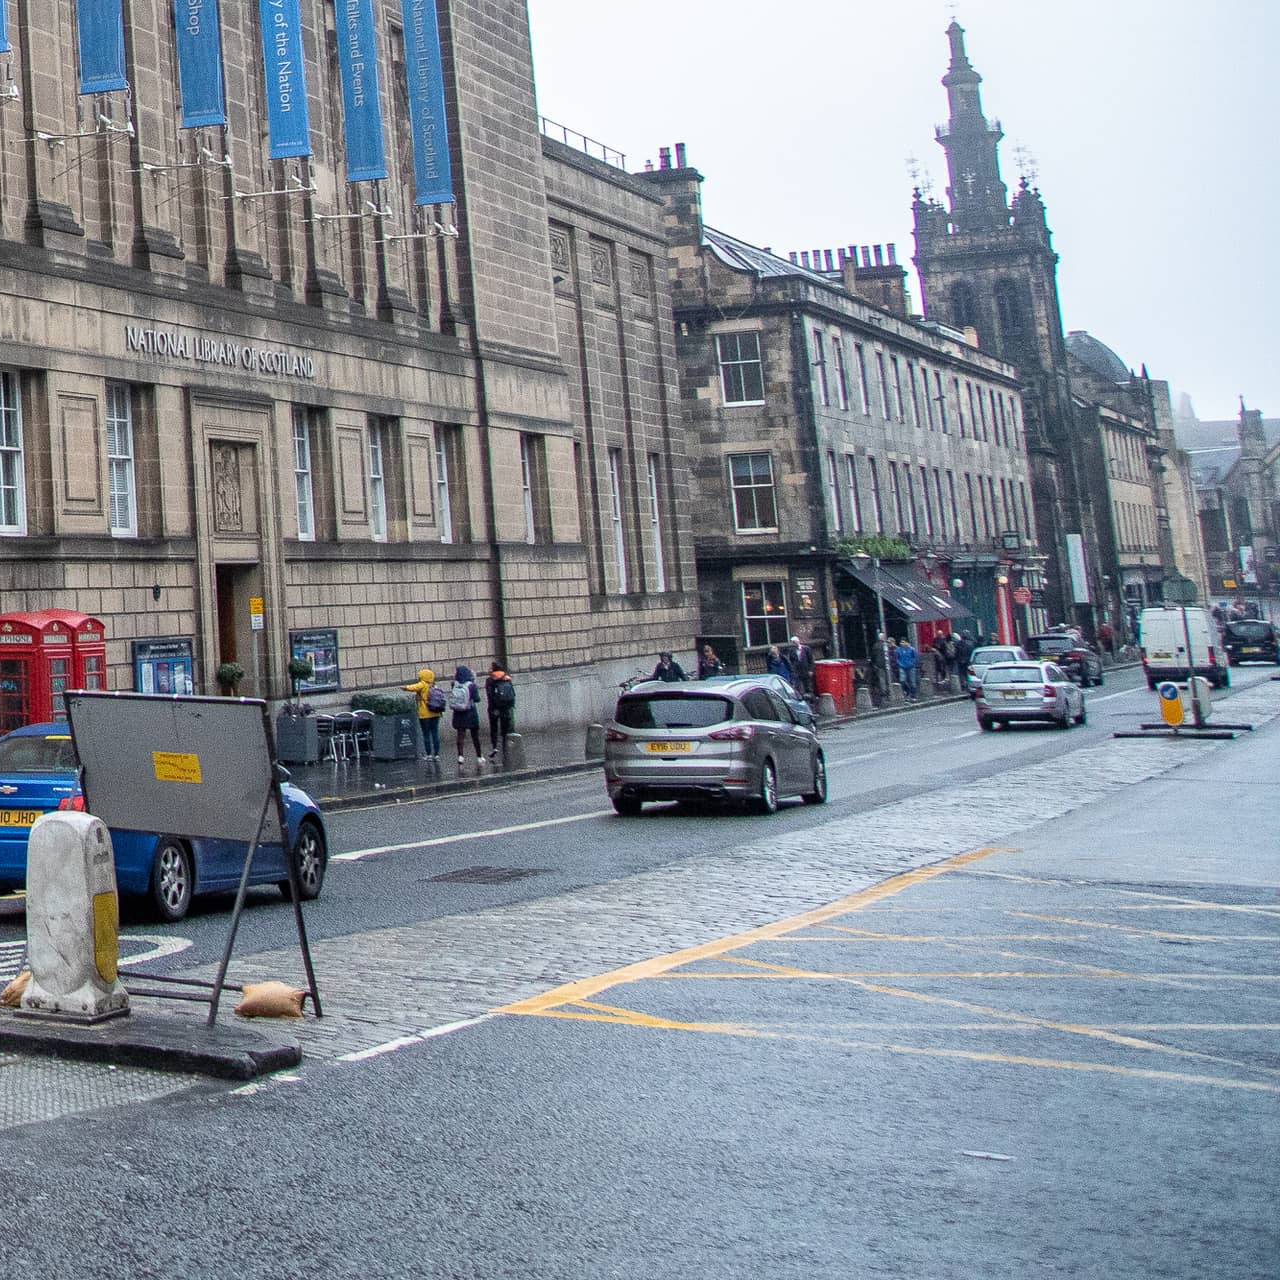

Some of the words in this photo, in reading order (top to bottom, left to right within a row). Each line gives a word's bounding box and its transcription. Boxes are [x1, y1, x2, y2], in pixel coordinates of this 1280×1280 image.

[274, 12, 289, 28] of
[412, 0, 428, 54] National
[275, 31, 290, 57] the
[349, 33, 363, 59] and
[277, 61, 293, 113] Nation
[351, 62, 364, 108] Events
[416, 56, 430, 102] Library
[422, 107, 434, 121] of
[422, 123, 440, 179] Scotland
[125, 325, 192, 360] NATIONAL
[194, 337, 240, 366] LIBRARY
[241, 346, 258, 370] OF
[259, 350, 314, 378] SCOTLAND
